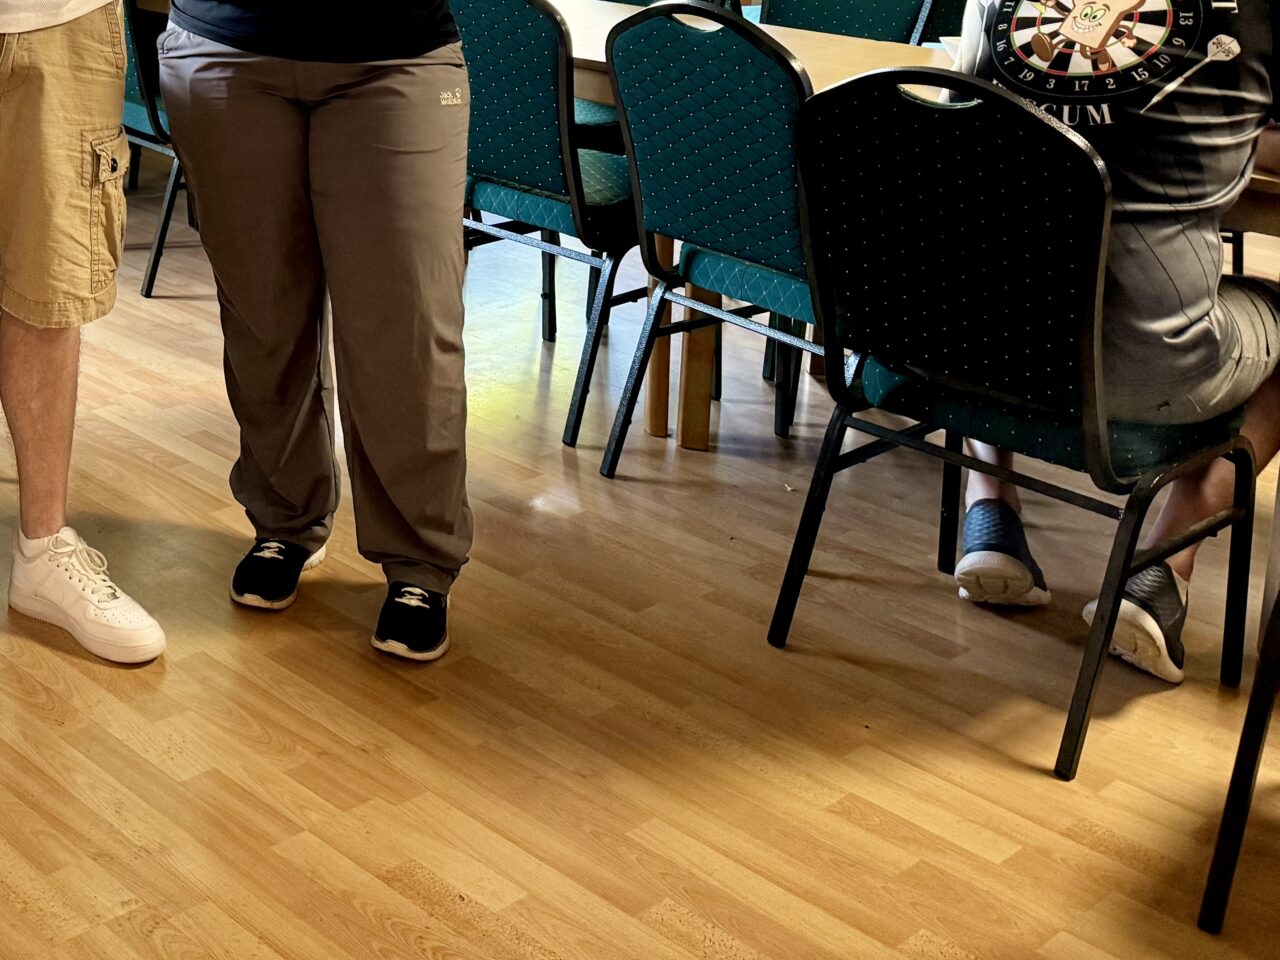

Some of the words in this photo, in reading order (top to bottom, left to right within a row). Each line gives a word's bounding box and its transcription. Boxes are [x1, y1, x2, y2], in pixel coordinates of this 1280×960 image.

[1003, 0, 1015, 12] 11
[1179, 11, 1194, 25] 13
[996, 39, 1008, 52] 16
[1004, 56, 1015, 65] 7
[1153, 54, 1171, 69] 10
[1018, 69, 1035, 81] 19
[1130, 66, 1150, 83] 15
[1046, 78, 1056, 89] 3
[1074, 80, 1089, 92] 17
[1105, 78, 1116, 89] 2
